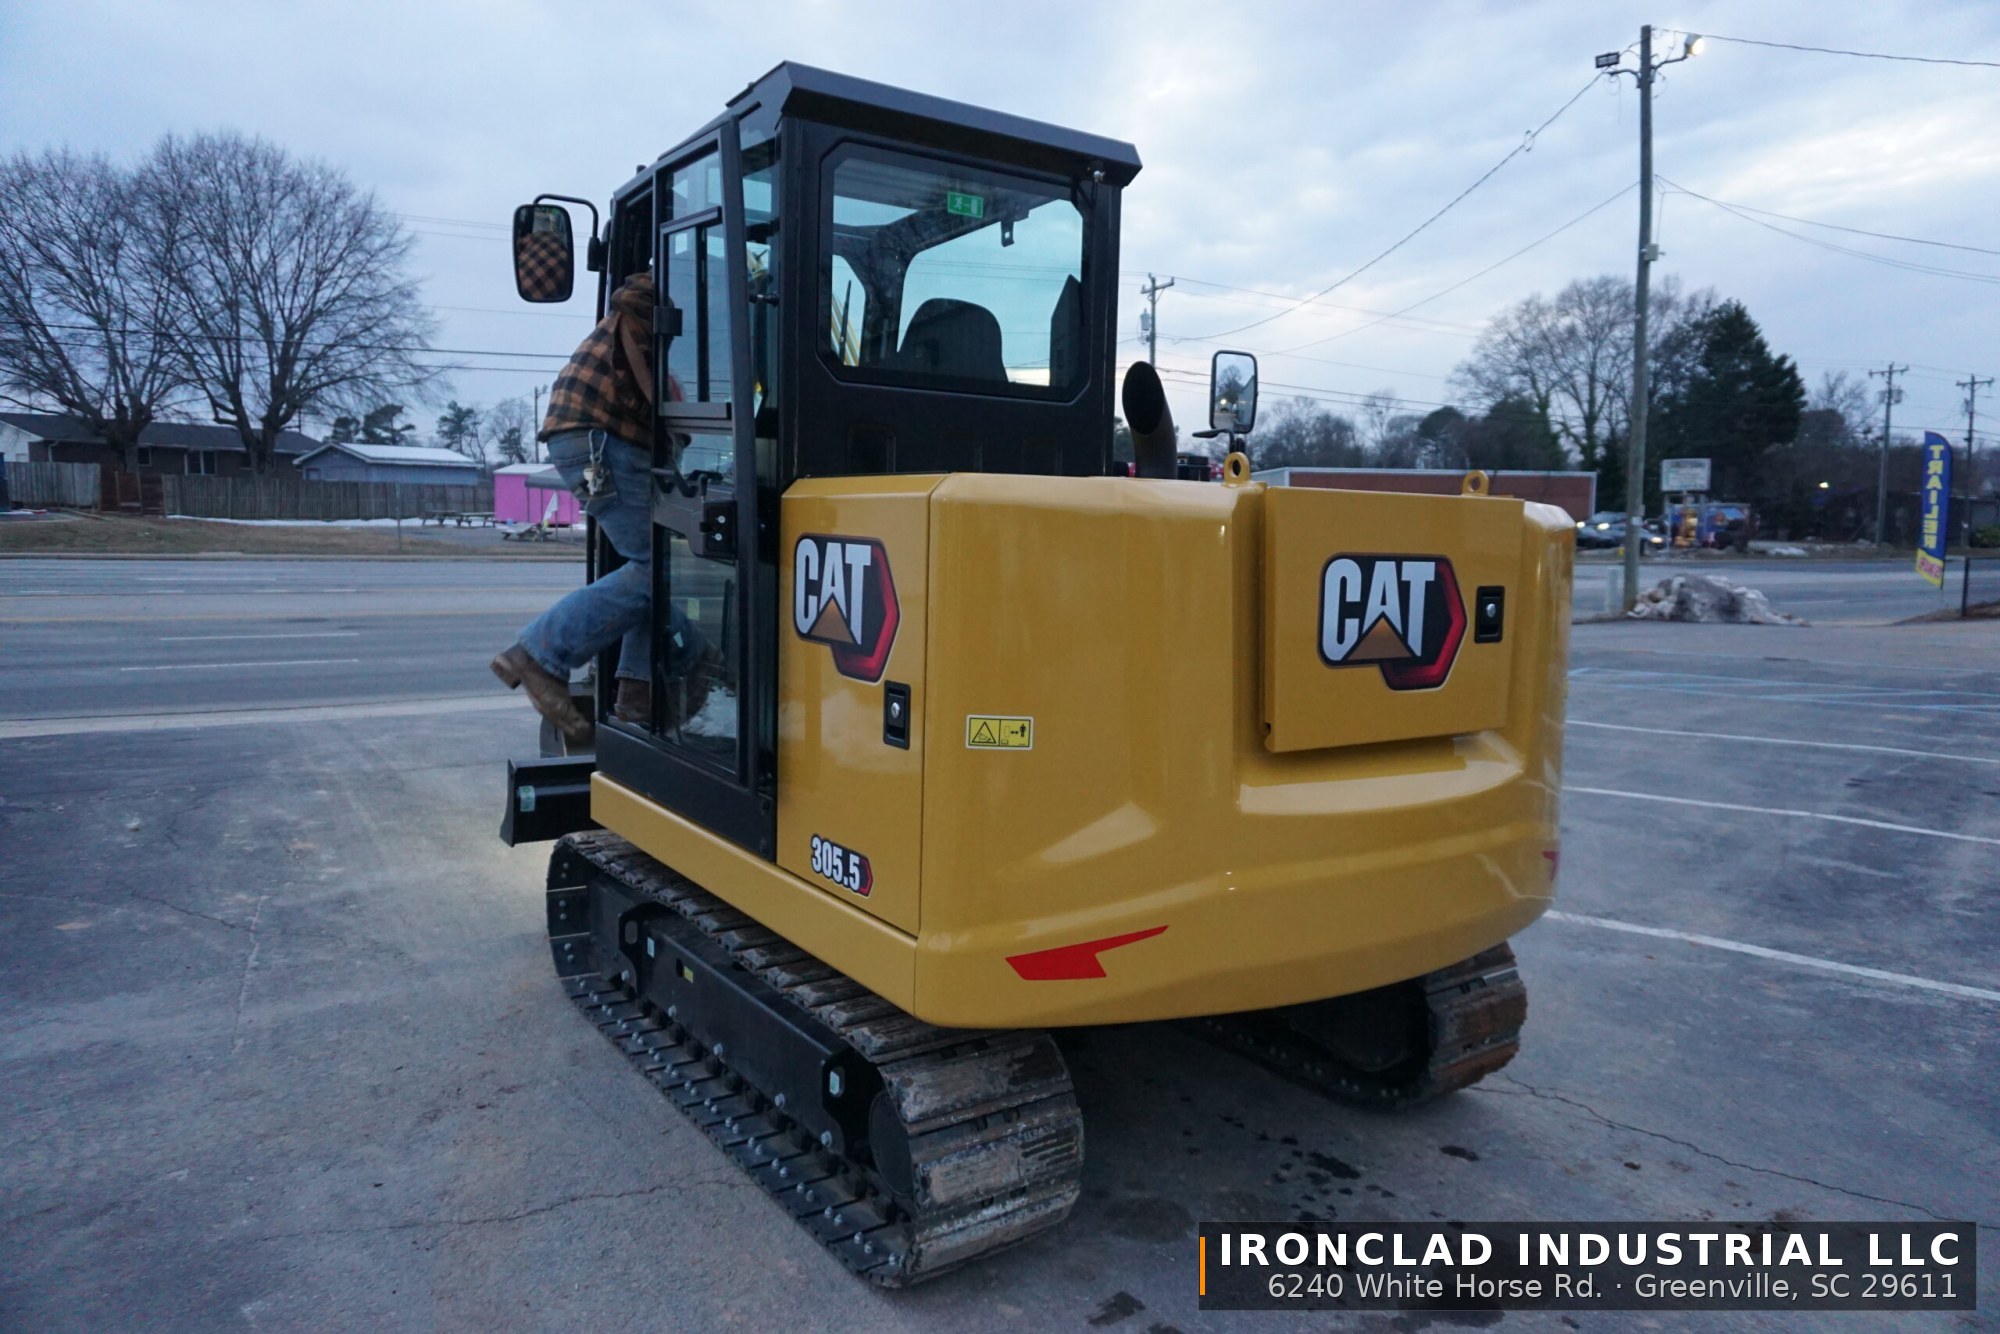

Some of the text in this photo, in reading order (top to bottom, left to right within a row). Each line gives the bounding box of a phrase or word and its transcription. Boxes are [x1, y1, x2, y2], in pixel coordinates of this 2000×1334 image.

[796, 538, 872, 645] CAT
[1322, 558, 1436, 661] CAT
[811, 836, 861, 892] 305.5
